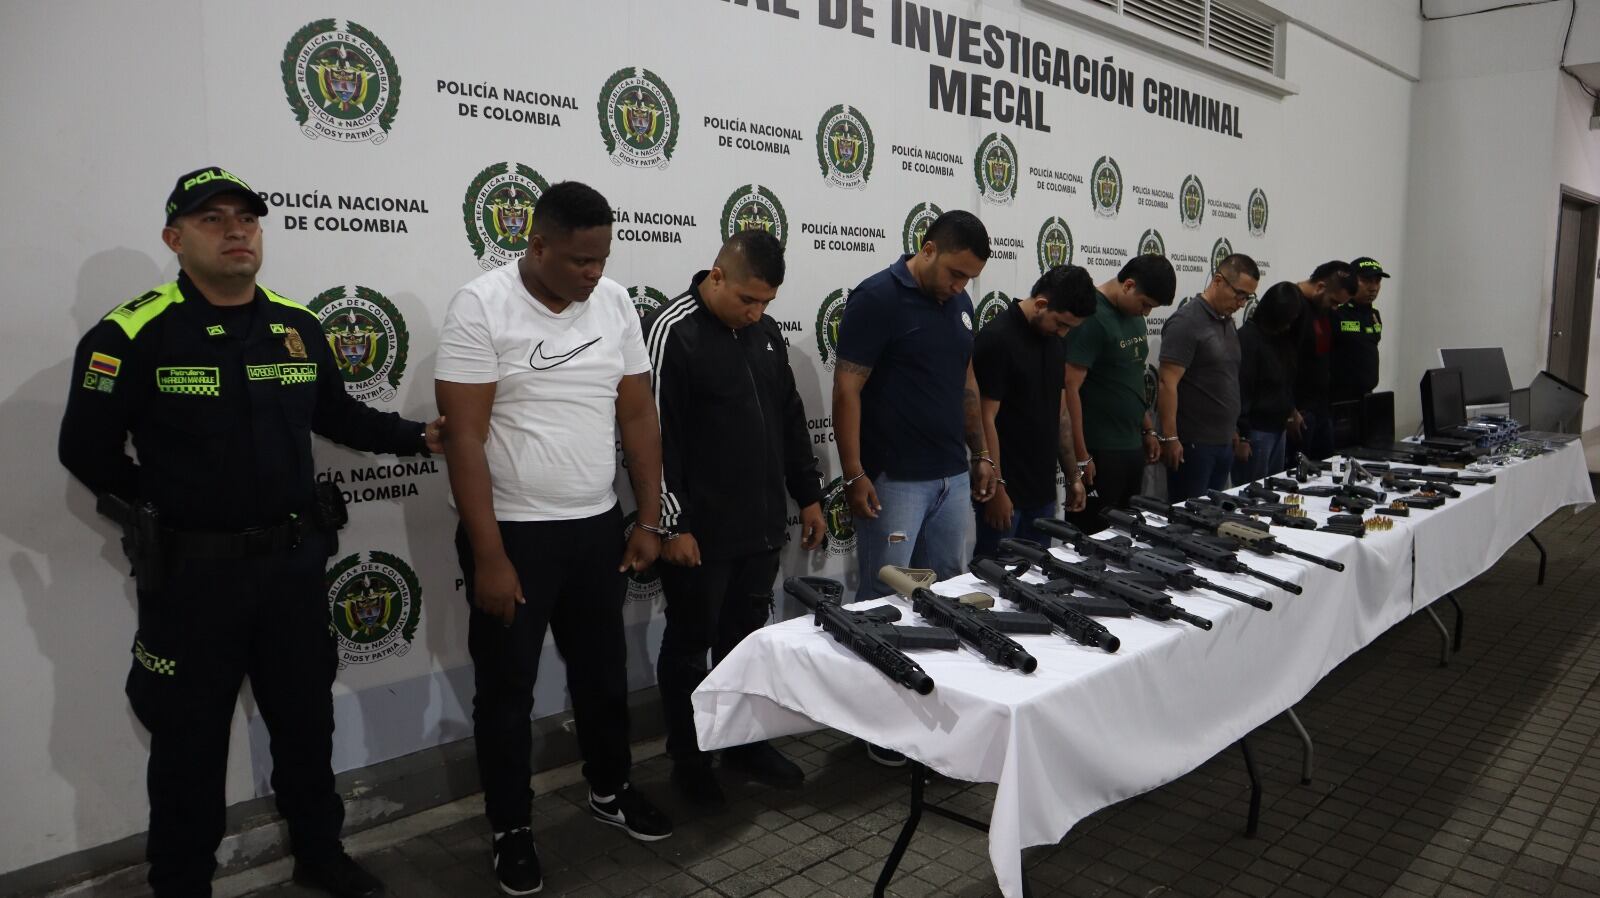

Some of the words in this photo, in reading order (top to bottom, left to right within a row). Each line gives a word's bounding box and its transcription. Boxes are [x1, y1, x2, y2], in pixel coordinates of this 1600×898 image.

[298, 35, 328, 82] REPUBLICA
[338, 33, 350, 42] DE
[360, 42, 388, 92] COLOMBIA
[892, 0, 1134, 108] INVESTIGACIÓN
[1143, 77, 1243, 139] CRIMINAL
[437, 80, 498, 100] POLICÍA
[504, 88, 578, 110] NACIONAL
[930, 64, 1051, 133] MECAL
[304, 95, 335, 125] POLICIA
[346, 103, 384, 128] NACIONAL
[458, 103, 478, 118] DE
[483, 106, 560, 127] COLOMBIA
[314, 123, 336, 137] DIOS
[346, 128, 375, 140] PATRIA
[704, 116, 746, 132] POLICÍA
[750, 123, 803, 140] NACIONAL
[718, 136, 732, 148] DE
[736, 138, 790, 154] COLOMBIA
[892, 143, 922, 158] POLICÍA
[925, 150, 964, 164] NACIONAL
[902, 160, 912, 171] DE
[914, 162, 954, 176] COLOMBIA
[1054, 170, 1084, 184] NACIONAL
[1037, 180, 1044, 190] DE
[1046, 182, 1076, 194] COLOMBIA
[1152, 189, 1174, 200] NACIONAL
[338, 196, 429, 214] NACIONAL
[1138, 198, 1144, 206] DE
[1146, 198, 1168, 208] COLOMBIA
[284, 216, 308, 230] DE
[314, 216, 408, 234] COLOMBIA
[634, 212, 696, 227] NACIONAL
[617, 229, 682, 244] COLOMBIA
[802, 222, 838, 236] POLICÍA
[840, 226, 886, 238] NACIONAL
[814, 240, 826, 250] DE
[828, 240, 876, 252] COLOMBIA
[994, 236, 1024, 248] NACIONAL
[1102, 247, 1128, 256] NACIONAL
[1088, 257, 1094, 265] DE
[1095, 258, 1122, 267] COLOMBIA
[368, 304, 396, 350] COLOMBIA
[282, 366, 314, 375] POLICÍA
[356, 360, 392, 390] NACIONAL
[356, 386, 384, 400] PATRIA
[808, 415, 832, 430] OLICÍ
[814, 434, 826, 444] DE
[351, 461, 438, 483] NACIONAL
[342, 483, 418, 504] OLOMBIA
[382, 566, 409, 607] COLOMBIA
[336, 634, 362, 651] OLICIA
[372, 617, 408, 650] NACIONAL
[344, 652, 363, 662] DIOS
[372, 642, 400, 660] PATRIA
